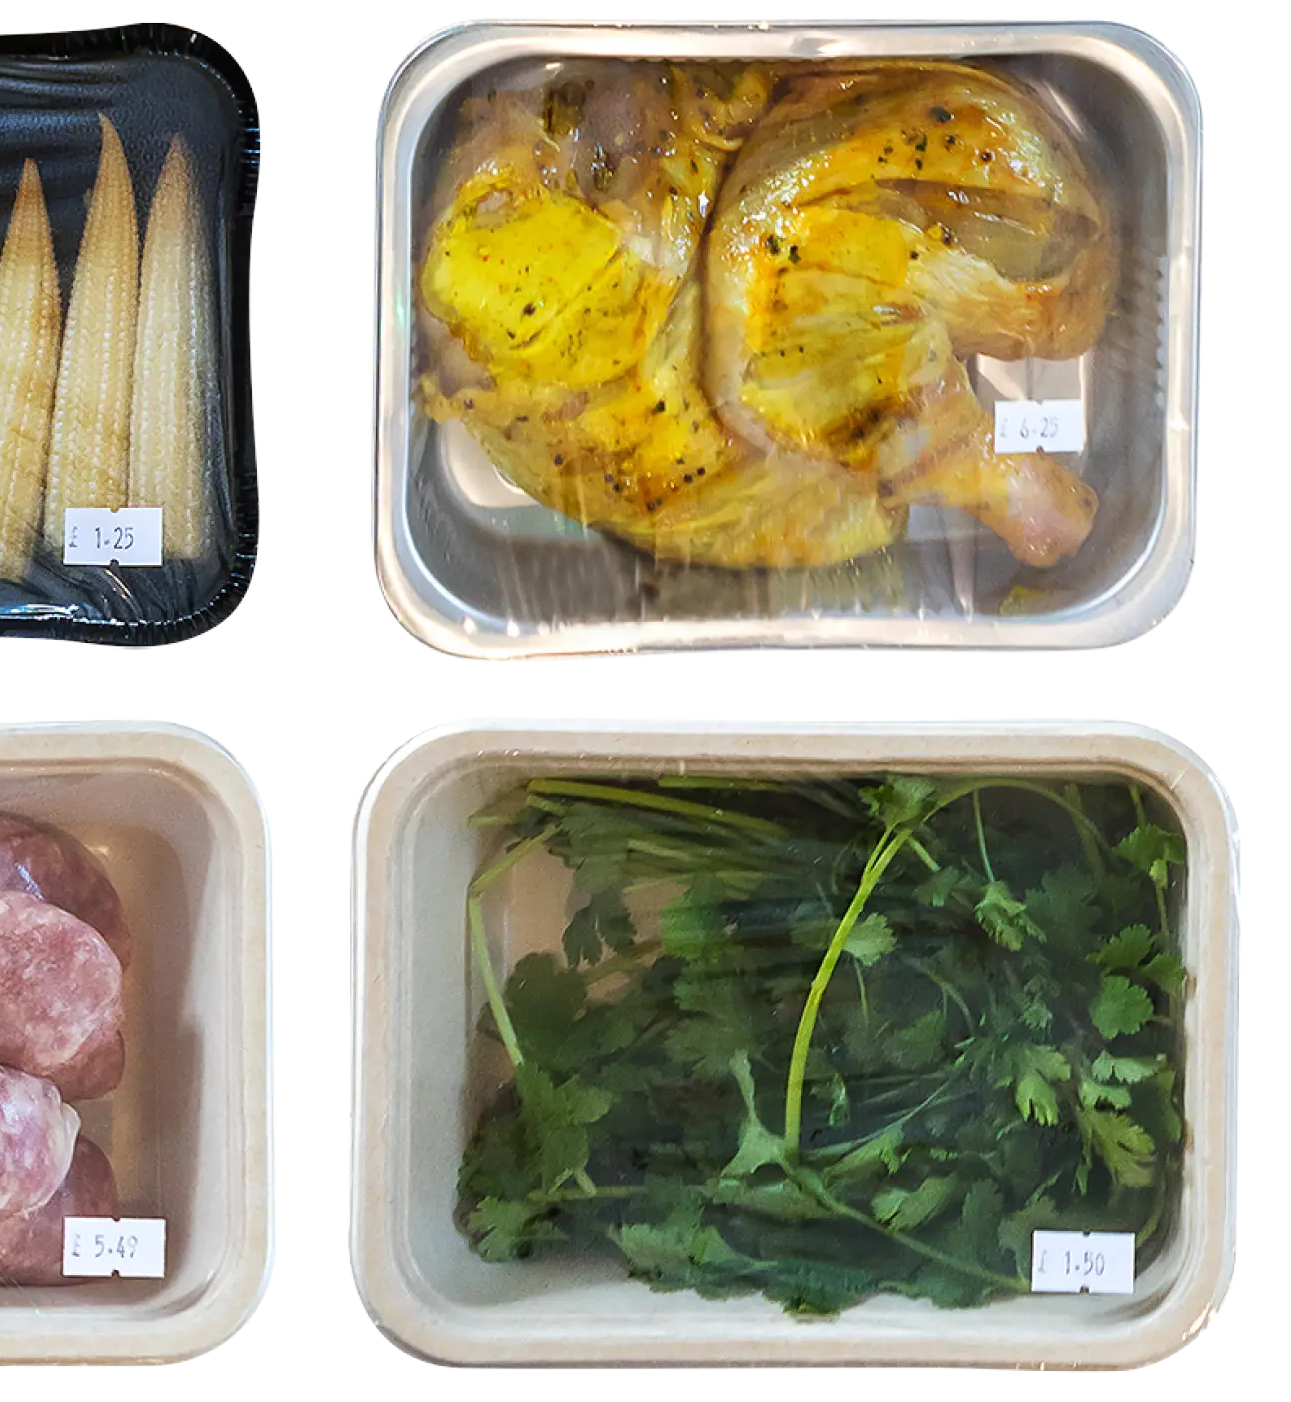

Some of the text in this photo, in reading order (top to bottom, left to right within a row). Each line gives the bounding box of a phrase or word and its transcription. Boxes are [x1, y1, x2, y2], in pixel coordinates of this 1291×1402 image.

[1020, 415, 1060, 439] 6.25
[94, 526, 135, 550] 1.25
[94, 1234, 139, 1258] 5.49
[1064, 1250, 1106, 1276] 1.50
